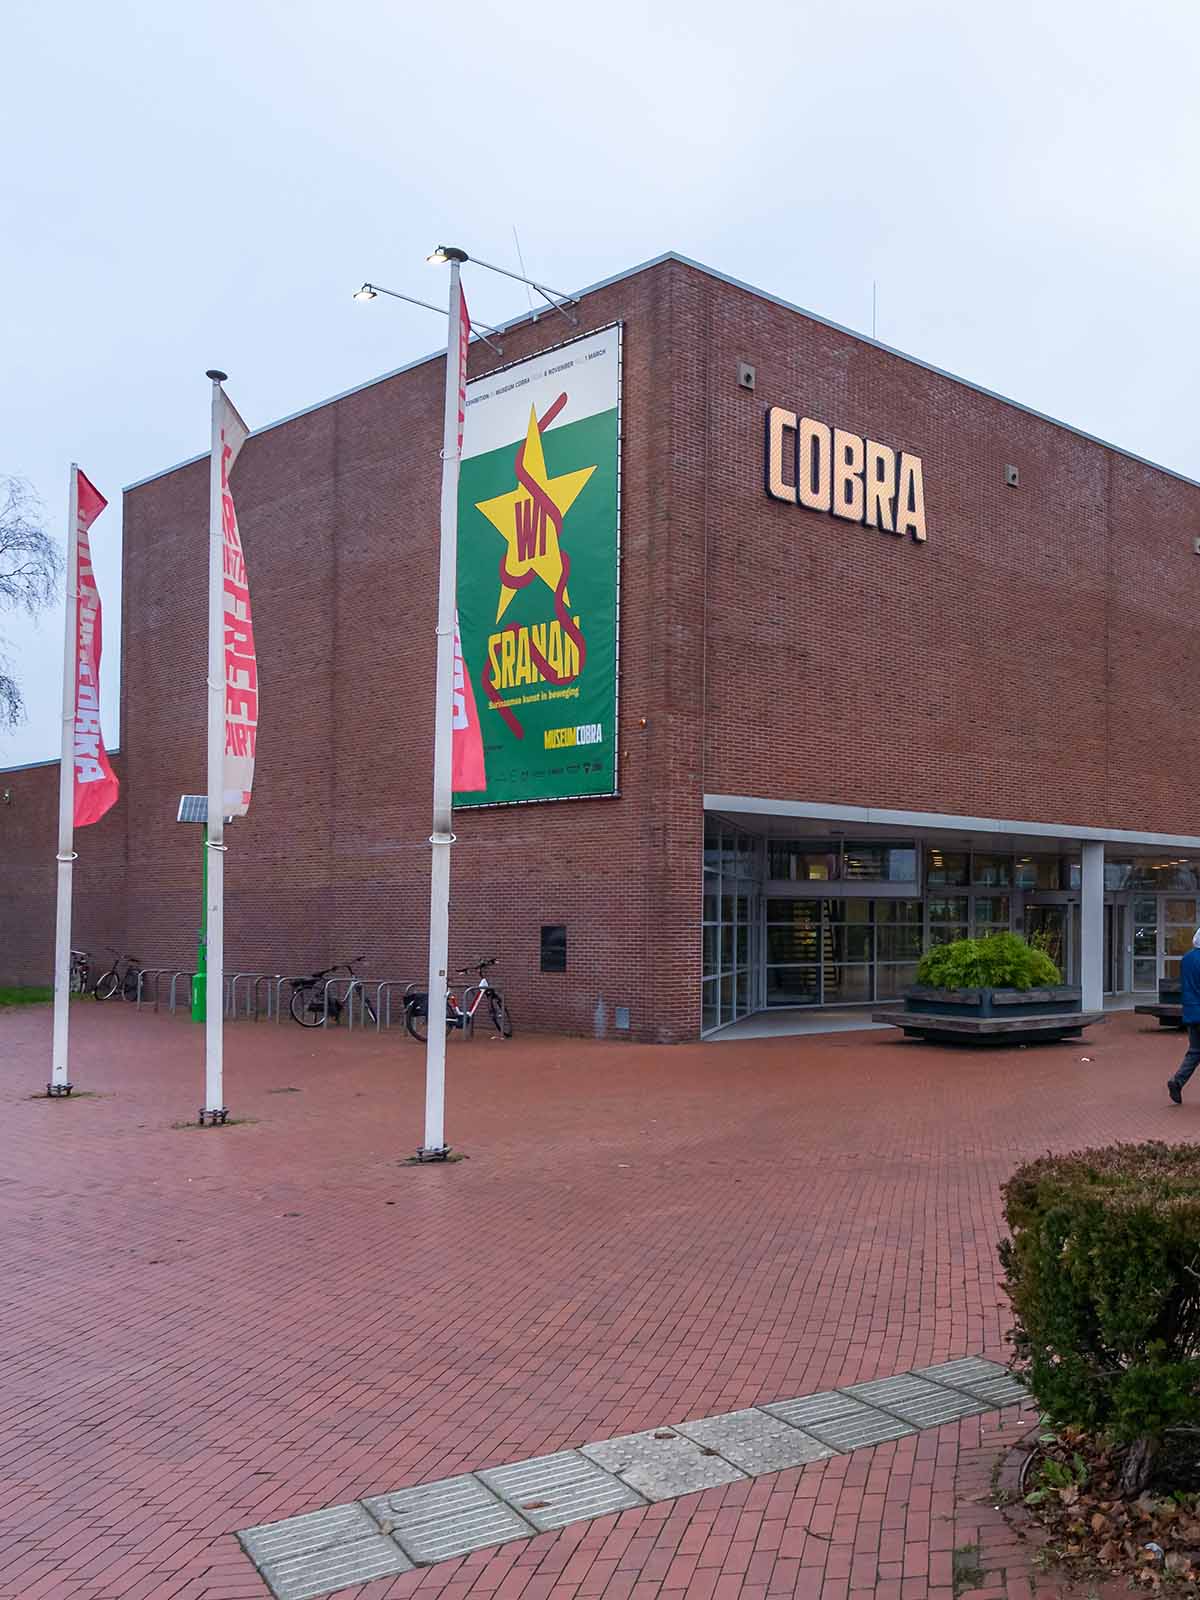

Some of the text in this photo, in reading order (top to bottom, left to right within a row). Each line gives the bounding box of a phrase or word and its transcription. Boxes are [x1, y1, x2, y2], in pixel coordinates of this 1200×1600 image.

[496, 383, 514, 396] MUSEUM
[515, 377, 530, 388] COBRA
[548, 360, 574, 375] NOVEMBER
[588, 349, 606, 361] MARCH
[766, 406, 927, 543] COBRA
[514, 497, 547, 563] WI
[488, 615, 580, 690] SRANAN
[548, 687, 580, 699] beweging
[224, 721, 257, 758] ART
